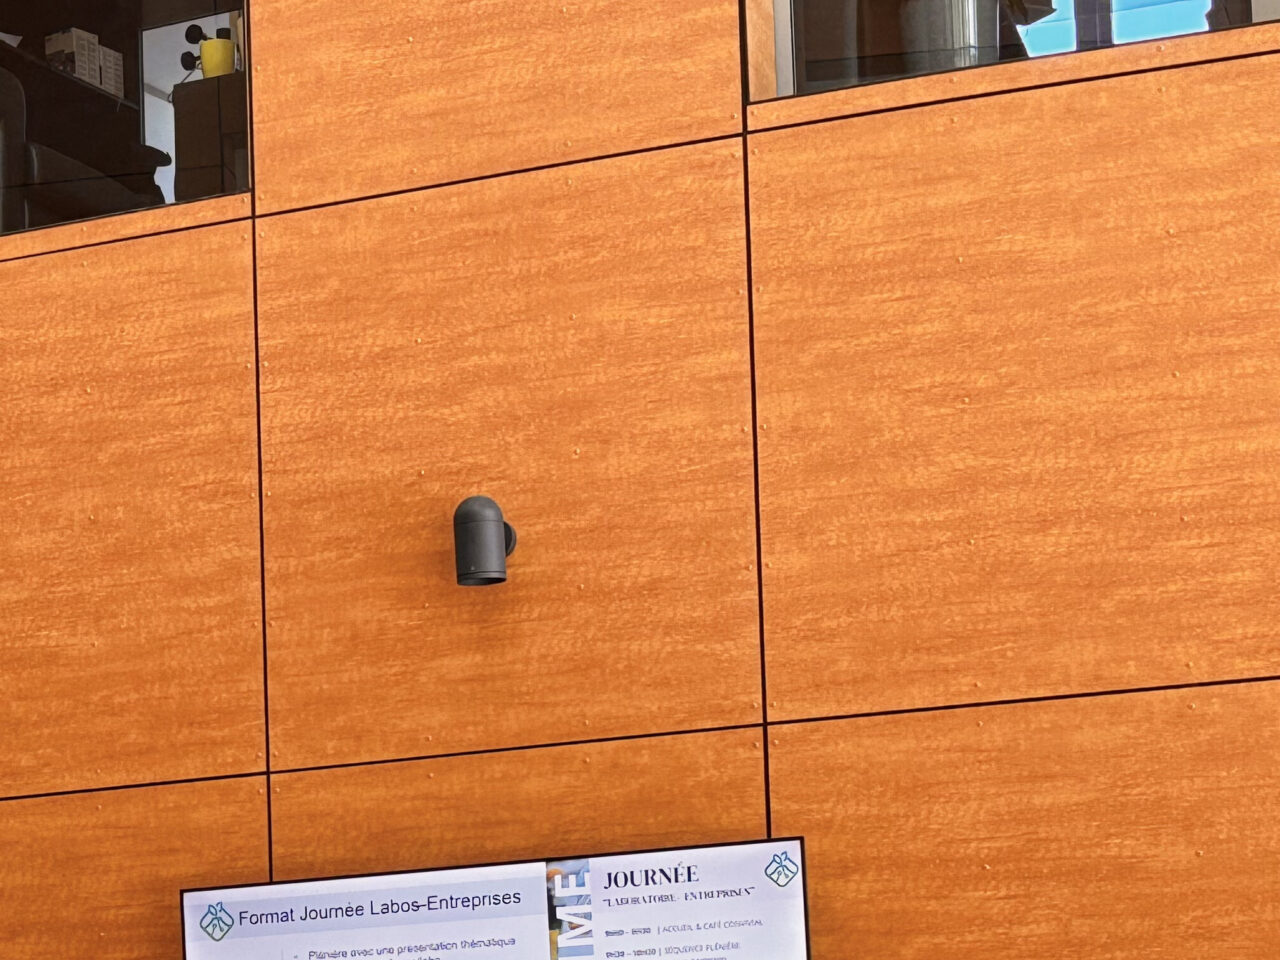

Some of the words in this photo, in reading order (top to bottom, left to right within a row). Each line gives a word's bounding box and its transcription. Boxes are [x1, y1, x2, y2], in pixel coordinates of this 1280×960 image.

[603, 861, 700, 890] JOURNÉE
[238, 909, 295, 926] Format
[299, 900, 365, 921] Journée
